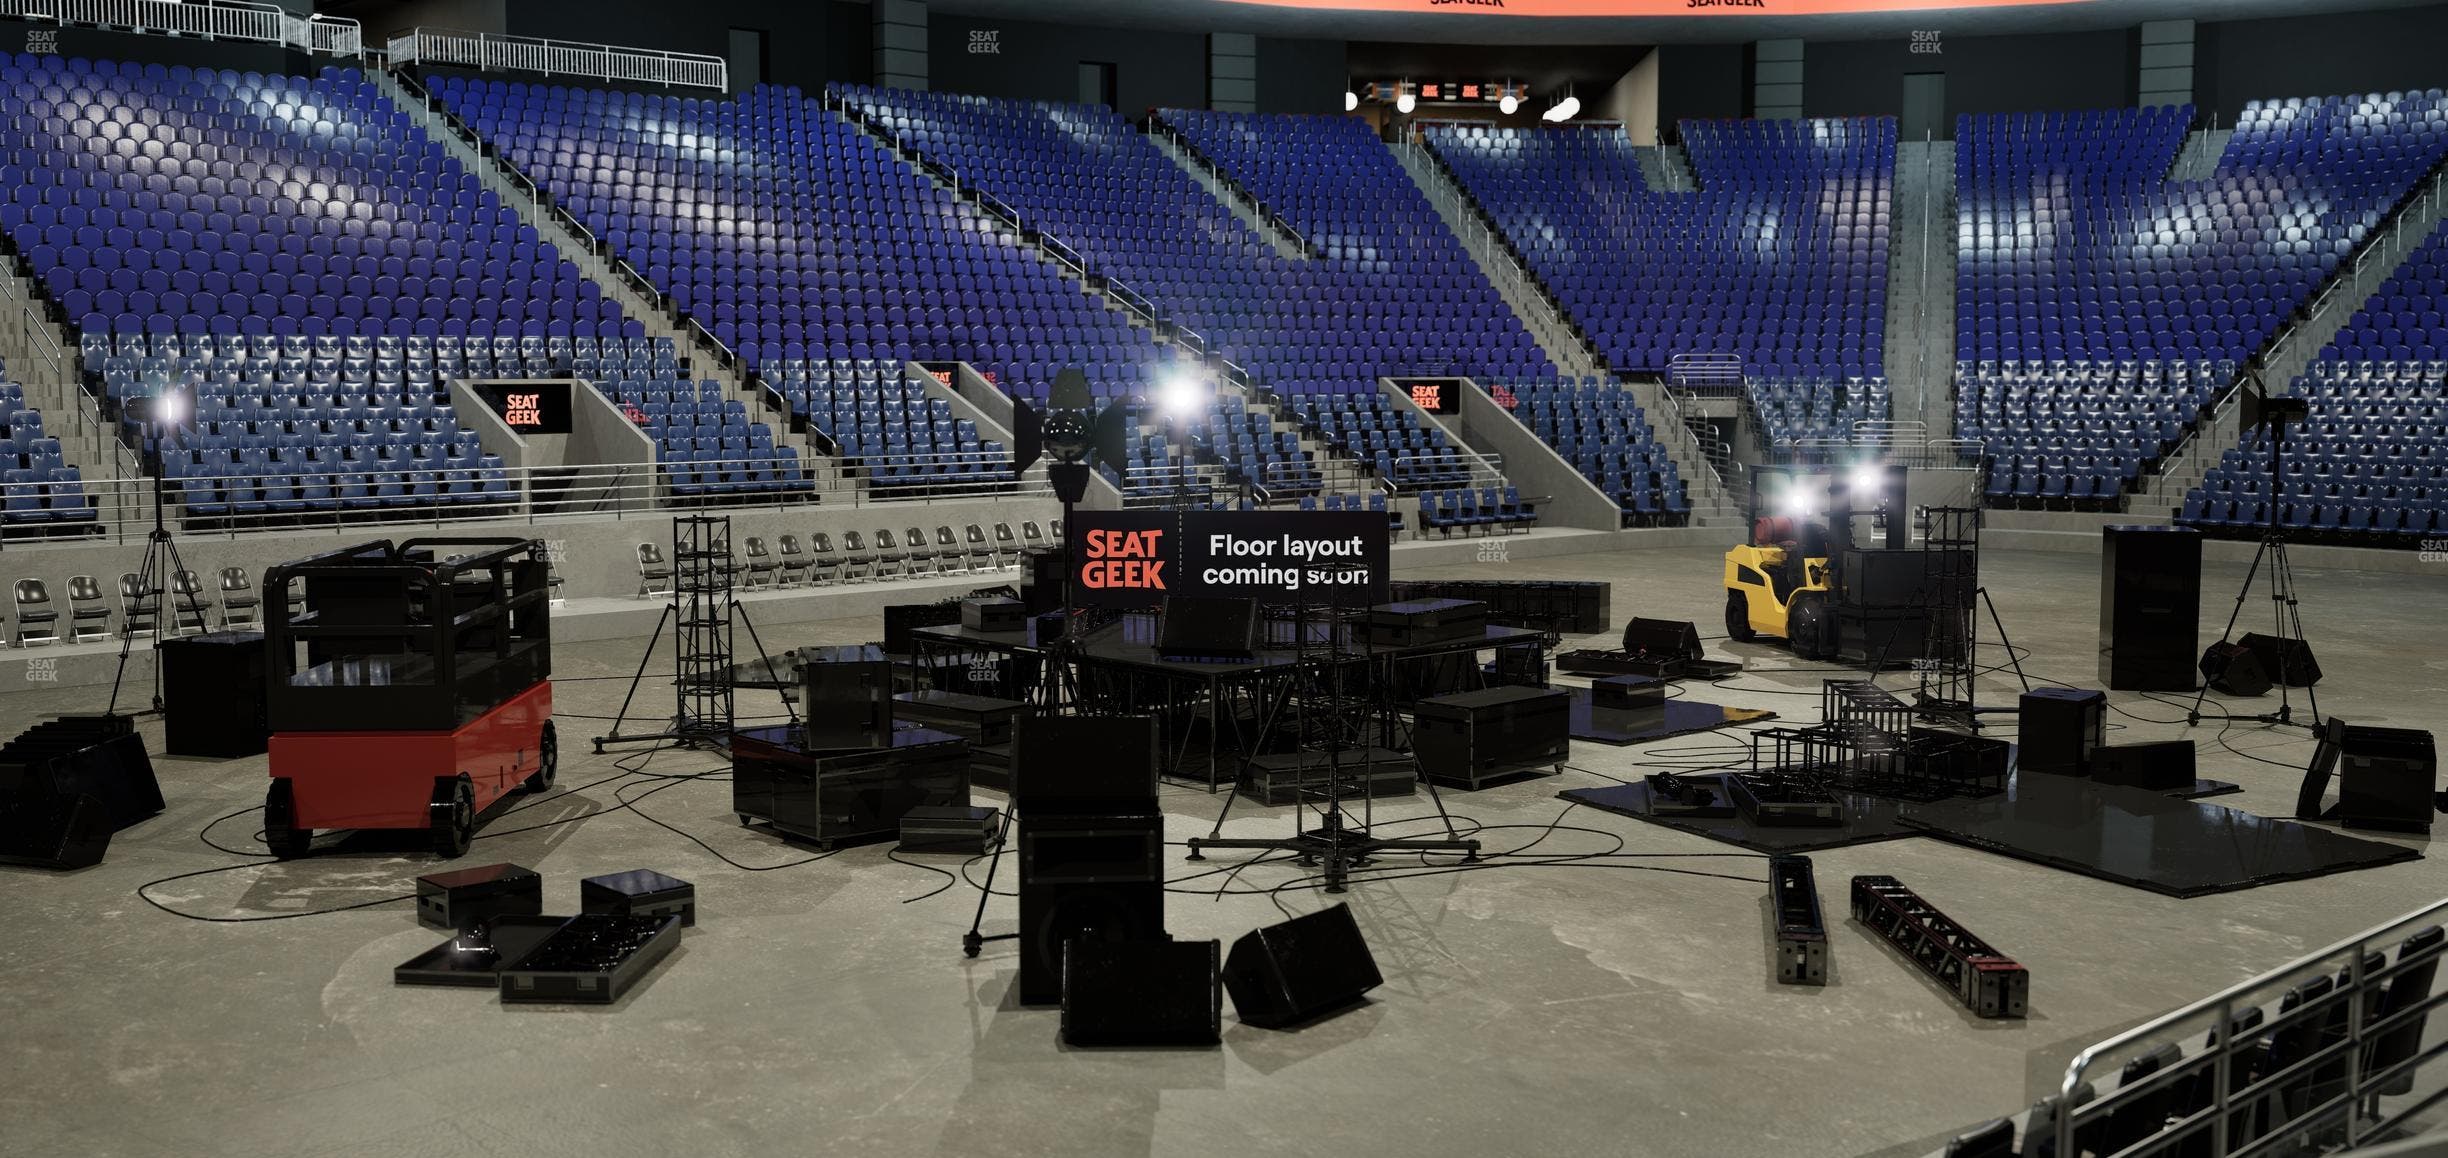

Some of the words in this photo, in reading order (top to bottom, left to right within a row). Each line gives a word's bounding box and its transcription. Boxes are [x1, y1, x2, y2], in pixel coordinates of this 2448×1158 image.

[507, 394, 540, 410] SEAT
[1412, 385, 1439, 397] SEAT
[505, 409, 541, 425] GEEK
[1086, 529, 1163, 559] SEAT
[1210, 533, 1278, 556] Floor
[1283, 533, 1363, 562] layout
[1081, 560, 1167, 590] GEEK
[1202, 562, 1299, 590] coming
[1305, 567, 1370, 585] soon
